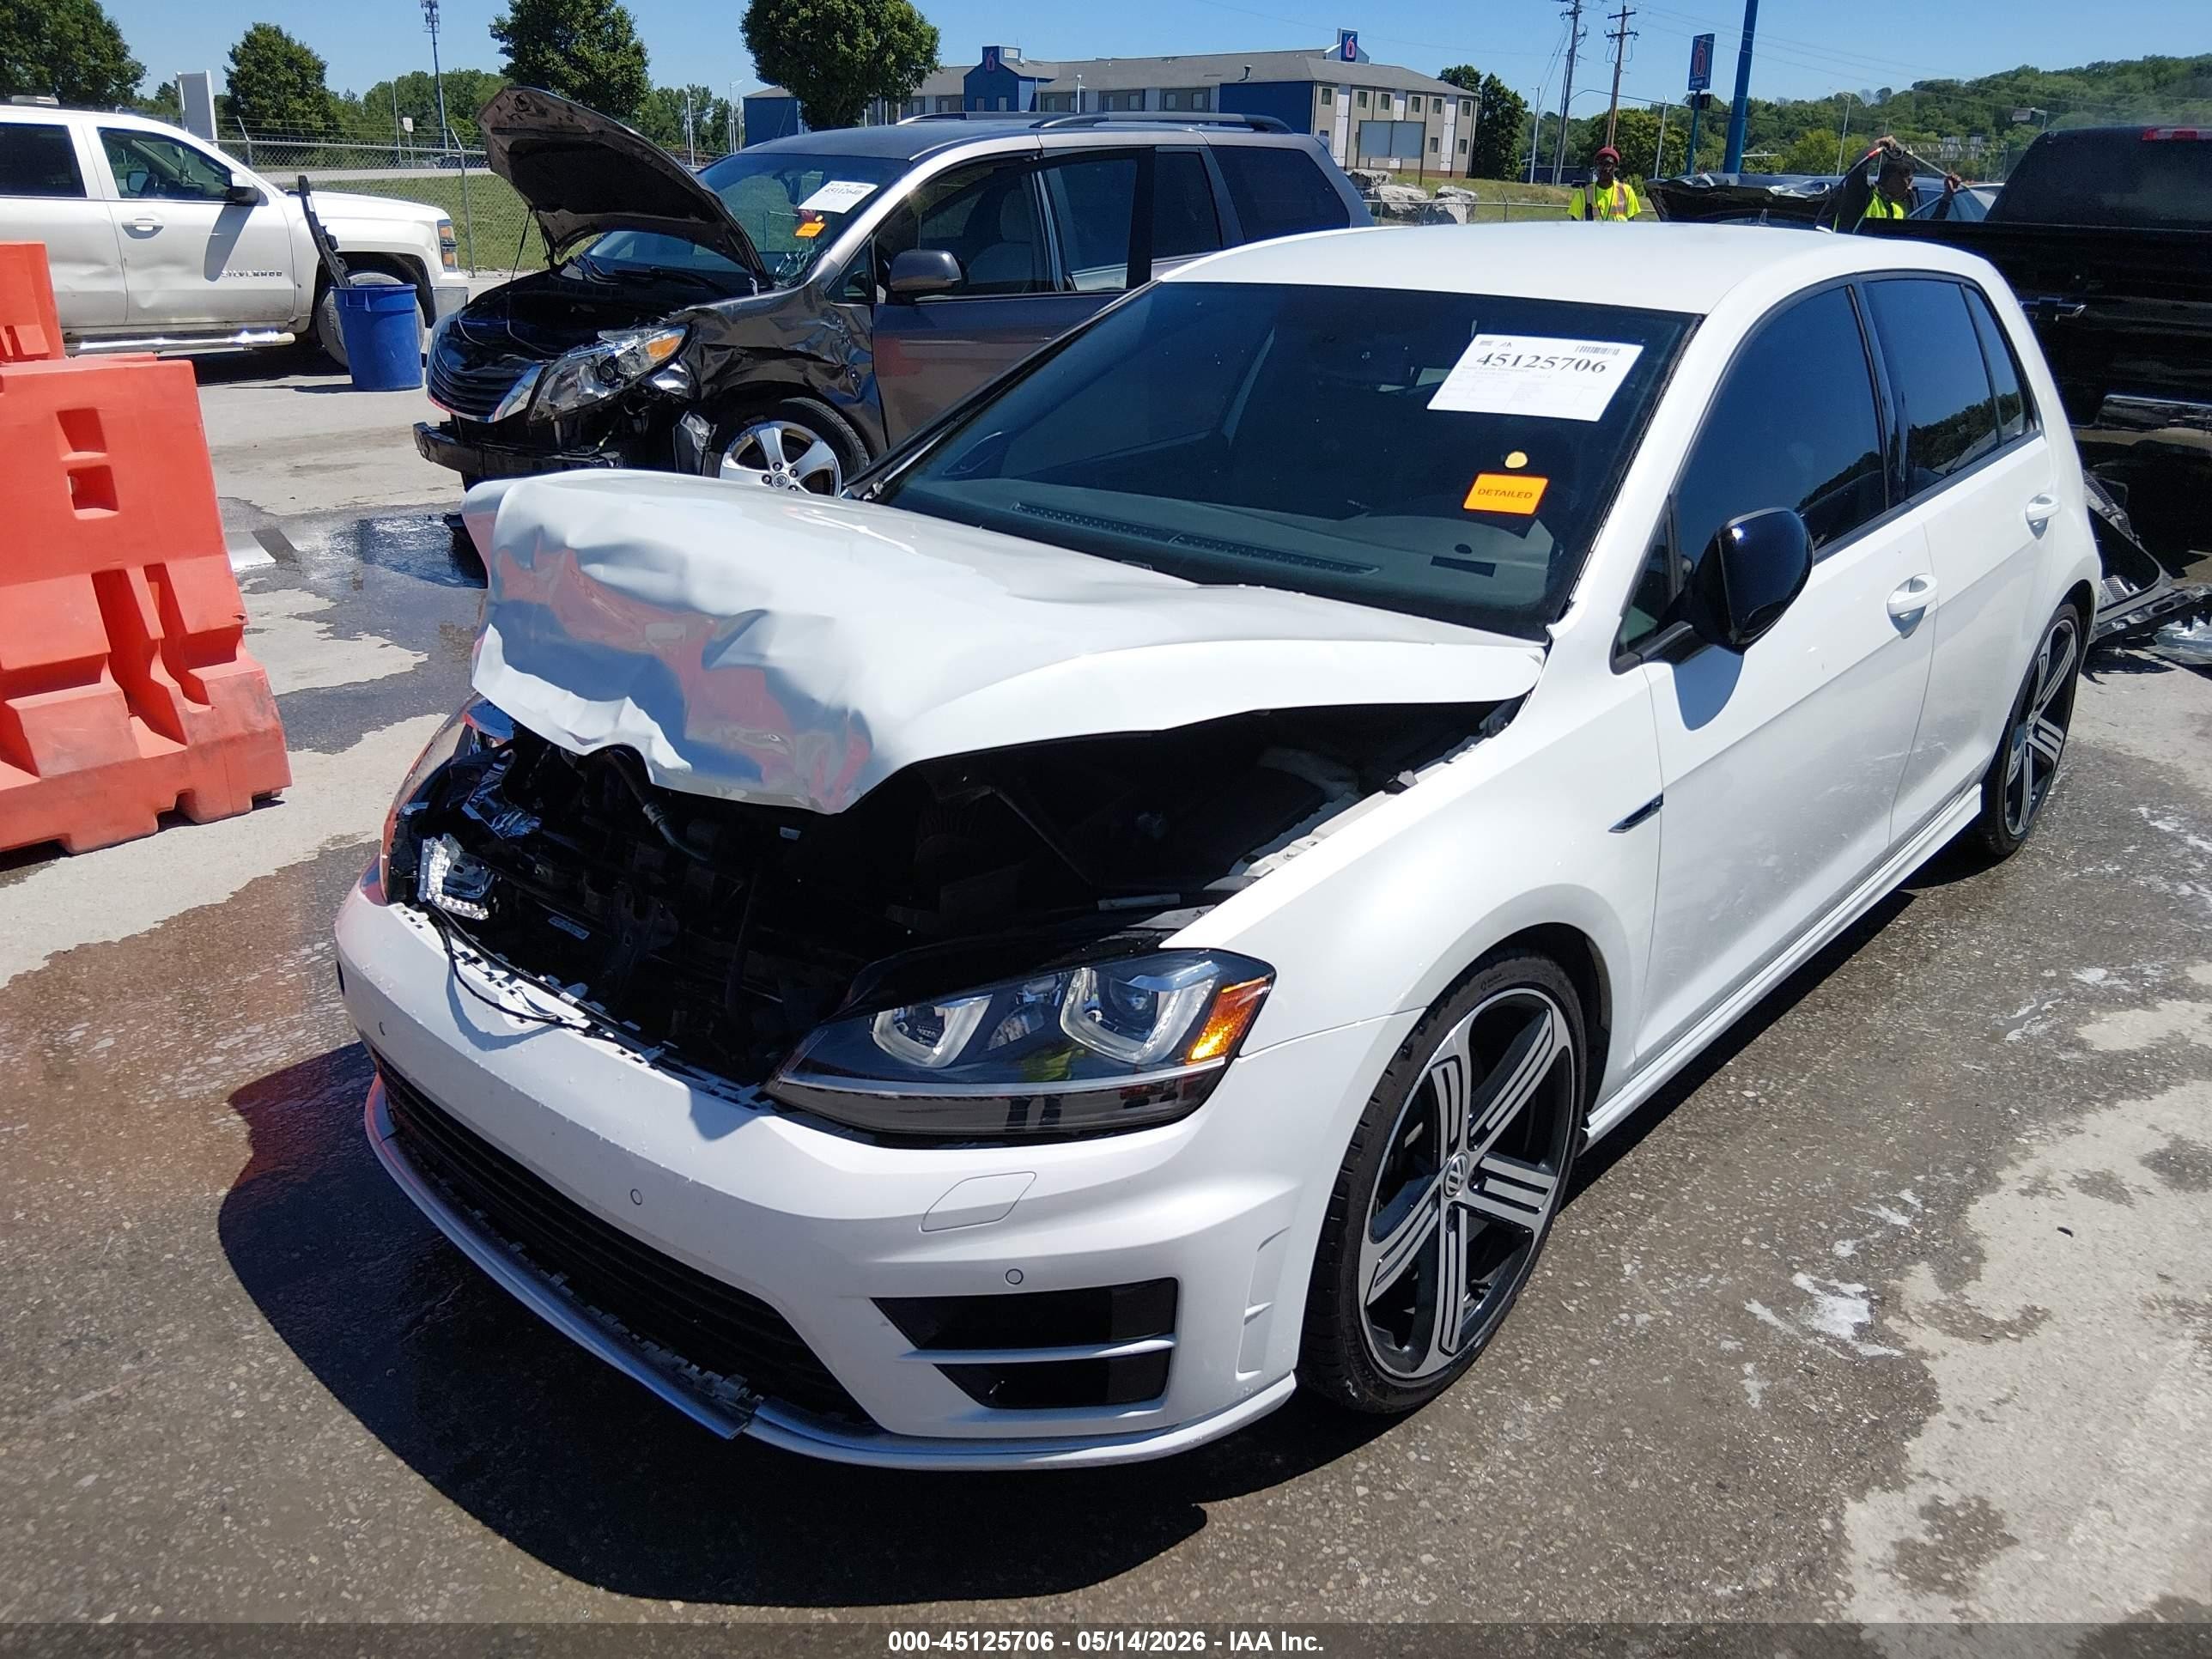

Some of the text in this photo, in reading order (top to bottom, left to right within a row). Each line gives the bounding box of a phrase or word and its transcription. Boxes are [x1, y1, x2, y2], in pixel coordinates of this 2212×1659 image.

[1346, 35, 1356, 58] 6
[1694, 40, 1706, 76] 6
[1477, 352, 1609, 373] 45125706
[1477, 488, 1533, 499] DETAILED
